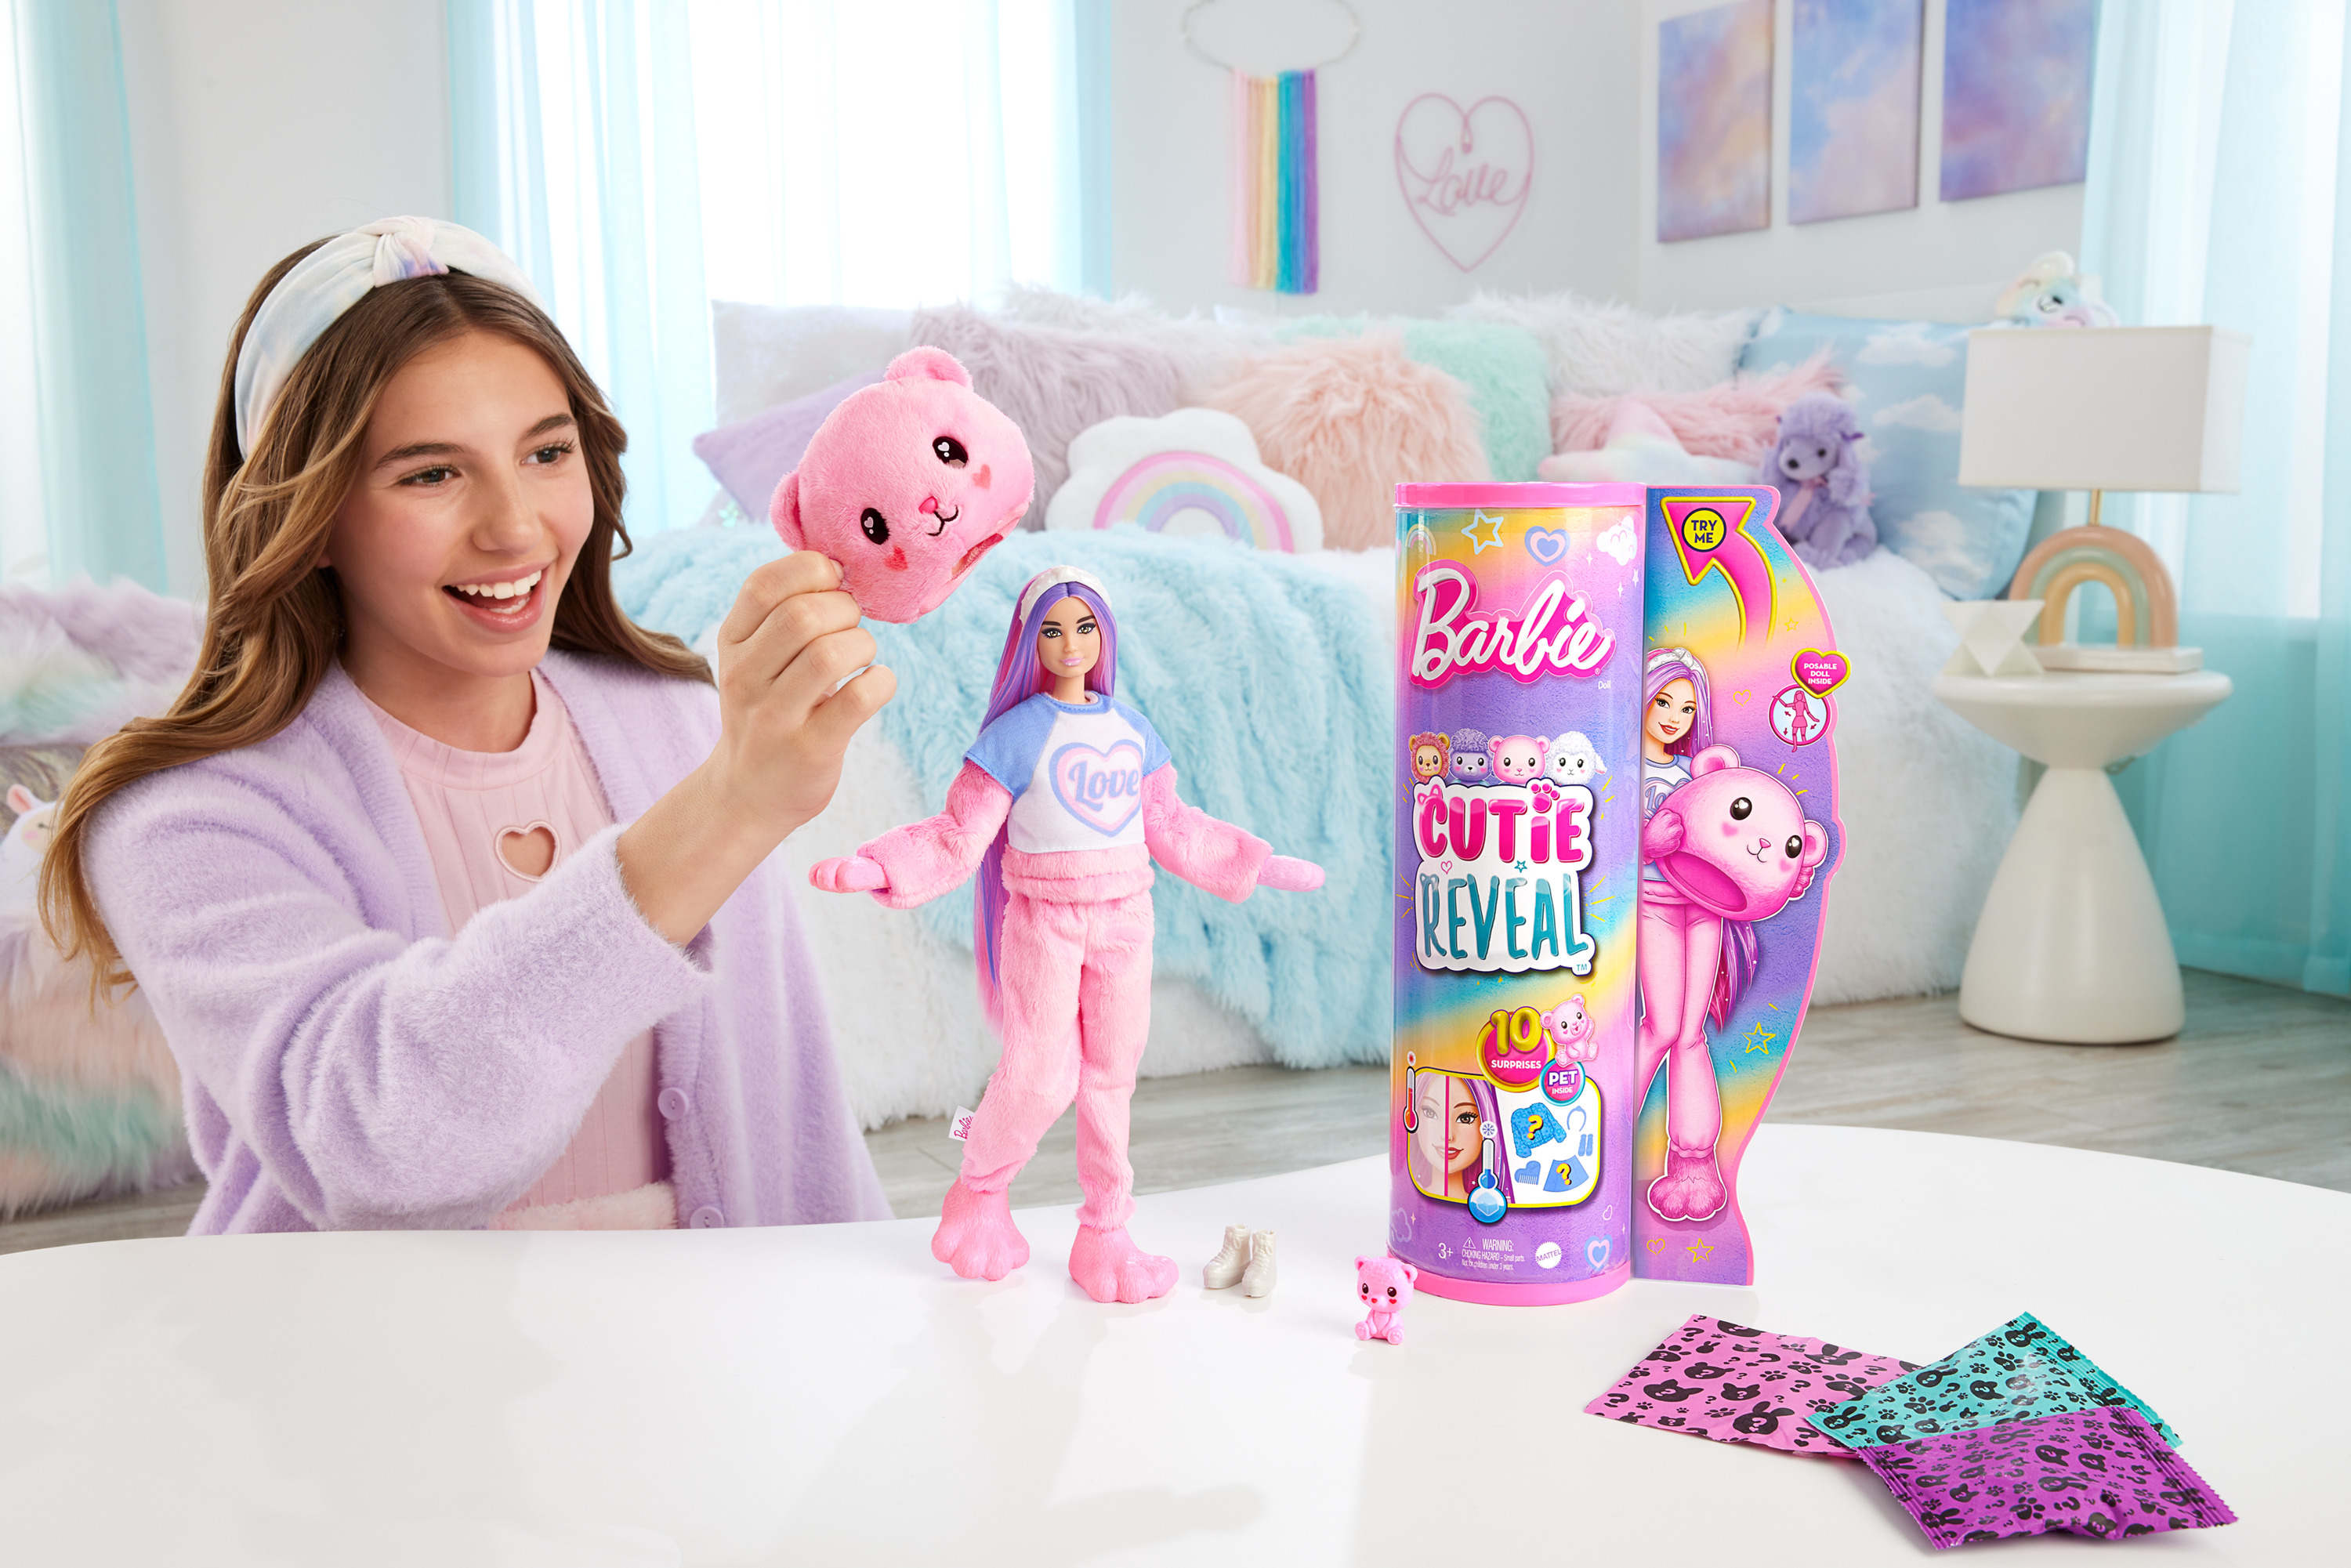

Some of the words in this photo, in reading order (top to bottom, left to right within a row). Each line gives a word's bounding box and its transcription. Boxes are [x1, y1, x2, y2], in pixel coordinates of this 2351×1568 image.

[1416, 145, 1508, 216] Love
[1691, 520, 1718, 531] TRY
[1694, 532, 1714, 544] ME
[1412, 567, 1611, 681] Barbie
[1598, 680, 1611, 690] Doll
[1068, 760, 1139, 813] Love
[1419, 872, 1588, 961] REVEAL
[1490, 1006, 1544, 1056] 10
[1491, 1059, 1542, 1070] SURPRISES
[1549, 1070, 1578, 1086] PET
[954, 1115, 973, 1139] Barbie
[1438, 1243, 1454, 1259] 3+
[1482, 1238, 1514, 1252] WARNING:
[1462, 1248, 1481, 1259] CHOKING
[1481, 1251, 1500, 1261] HAZARD
[1514, 1255, 1526, 1263] parts.
[1536, 1249, 1562, 1262] MATTEL
[1473, 1260, 1488, 1269] children
